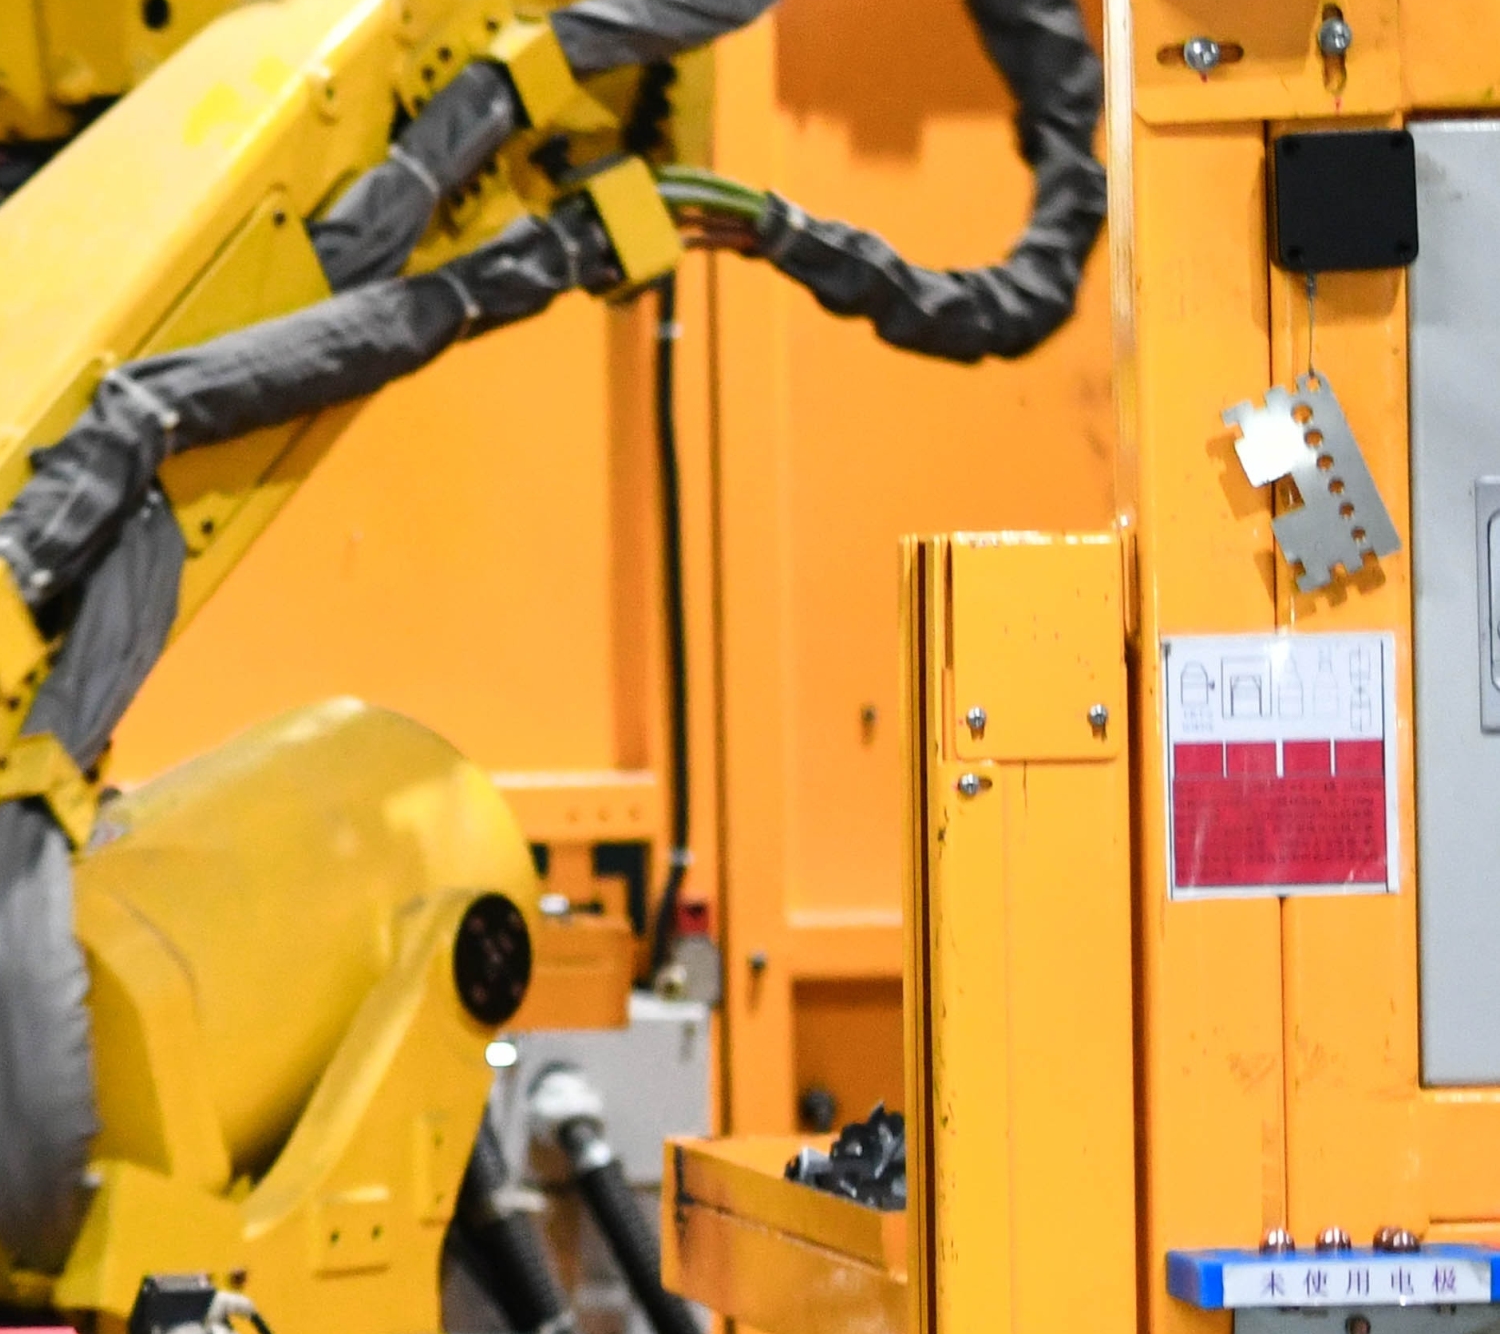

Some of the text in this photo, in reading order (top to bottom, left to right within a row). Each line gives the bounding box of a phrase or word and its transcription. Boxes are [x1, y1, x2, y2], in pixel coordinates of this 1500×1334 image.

[1260, 1266, 1457, 1298] 未使用电极
